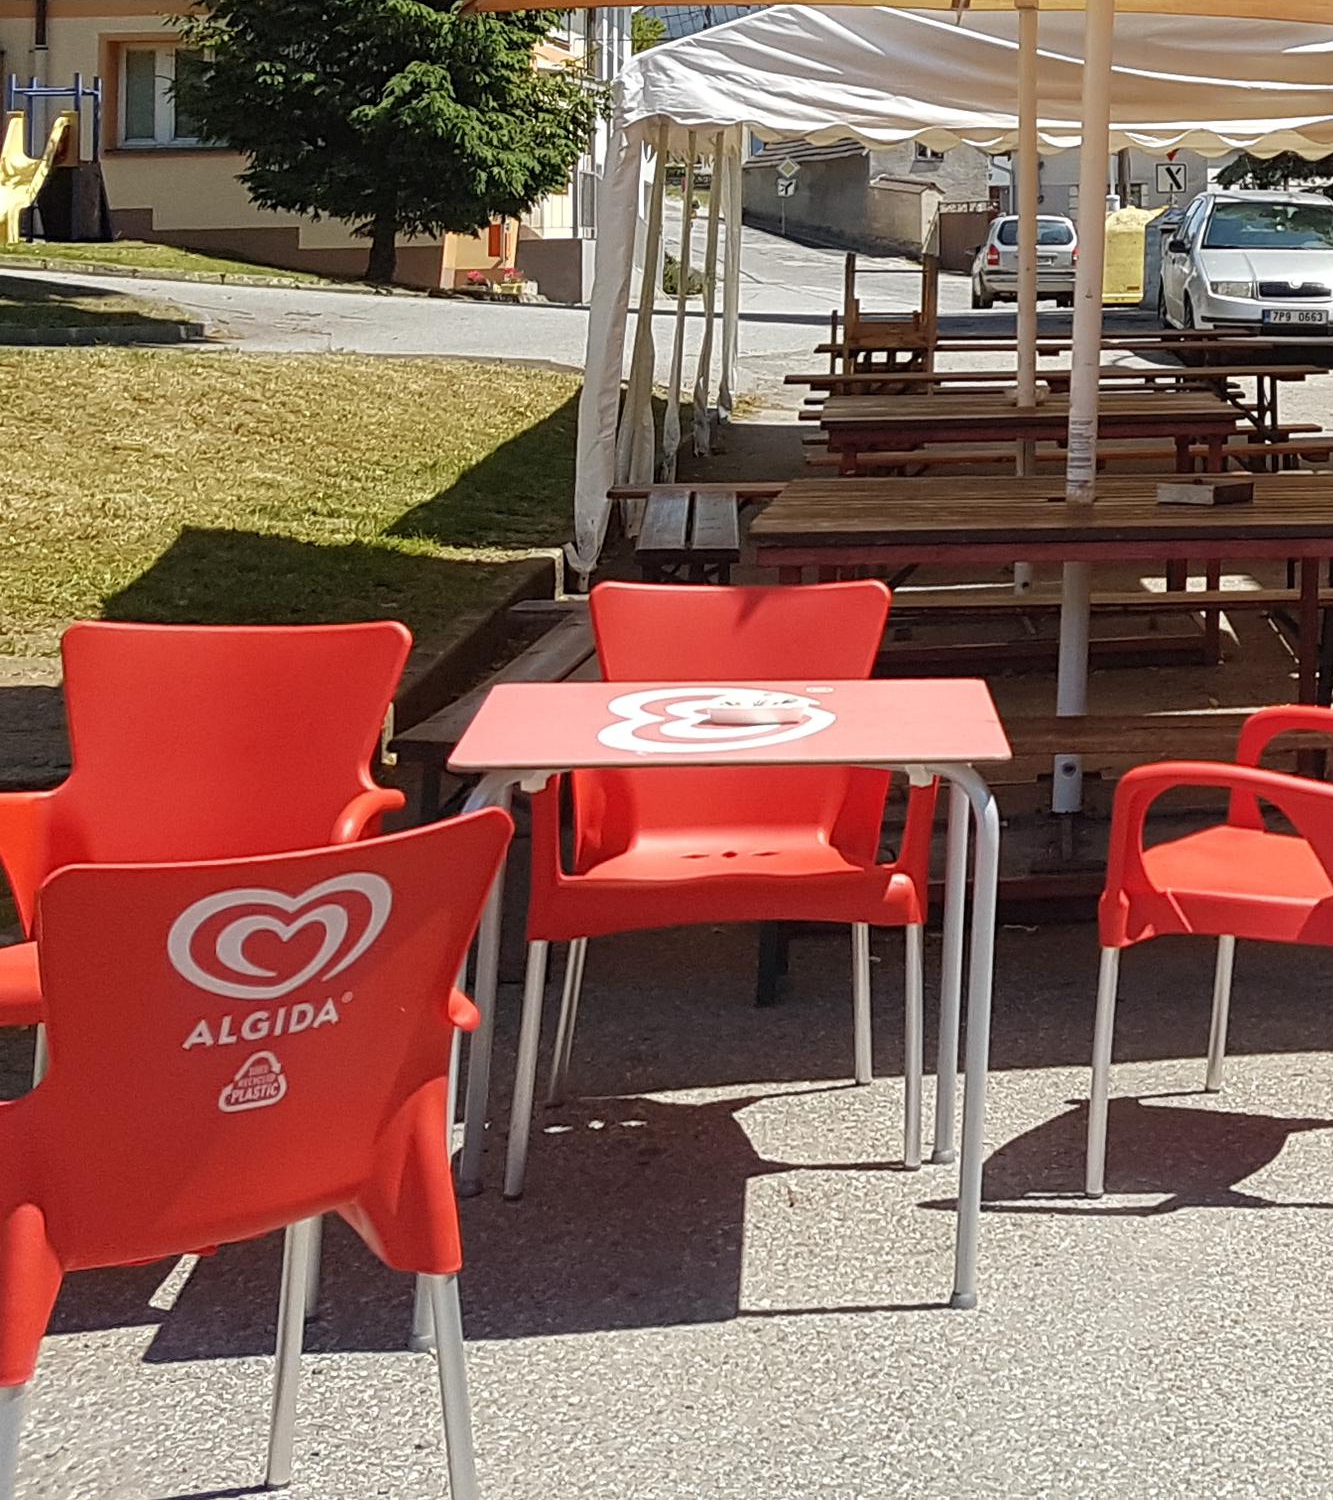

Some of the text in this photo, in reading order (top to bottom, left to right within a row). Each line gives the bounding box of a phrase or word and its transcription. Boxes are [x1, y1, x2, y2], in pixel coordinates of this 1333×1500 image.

[1273, 311, 1323, 322] 7P9 0663
[182, 996, 340, 1050] ALGIDA
[230, 1080, 279, 1104] PLASTIC
